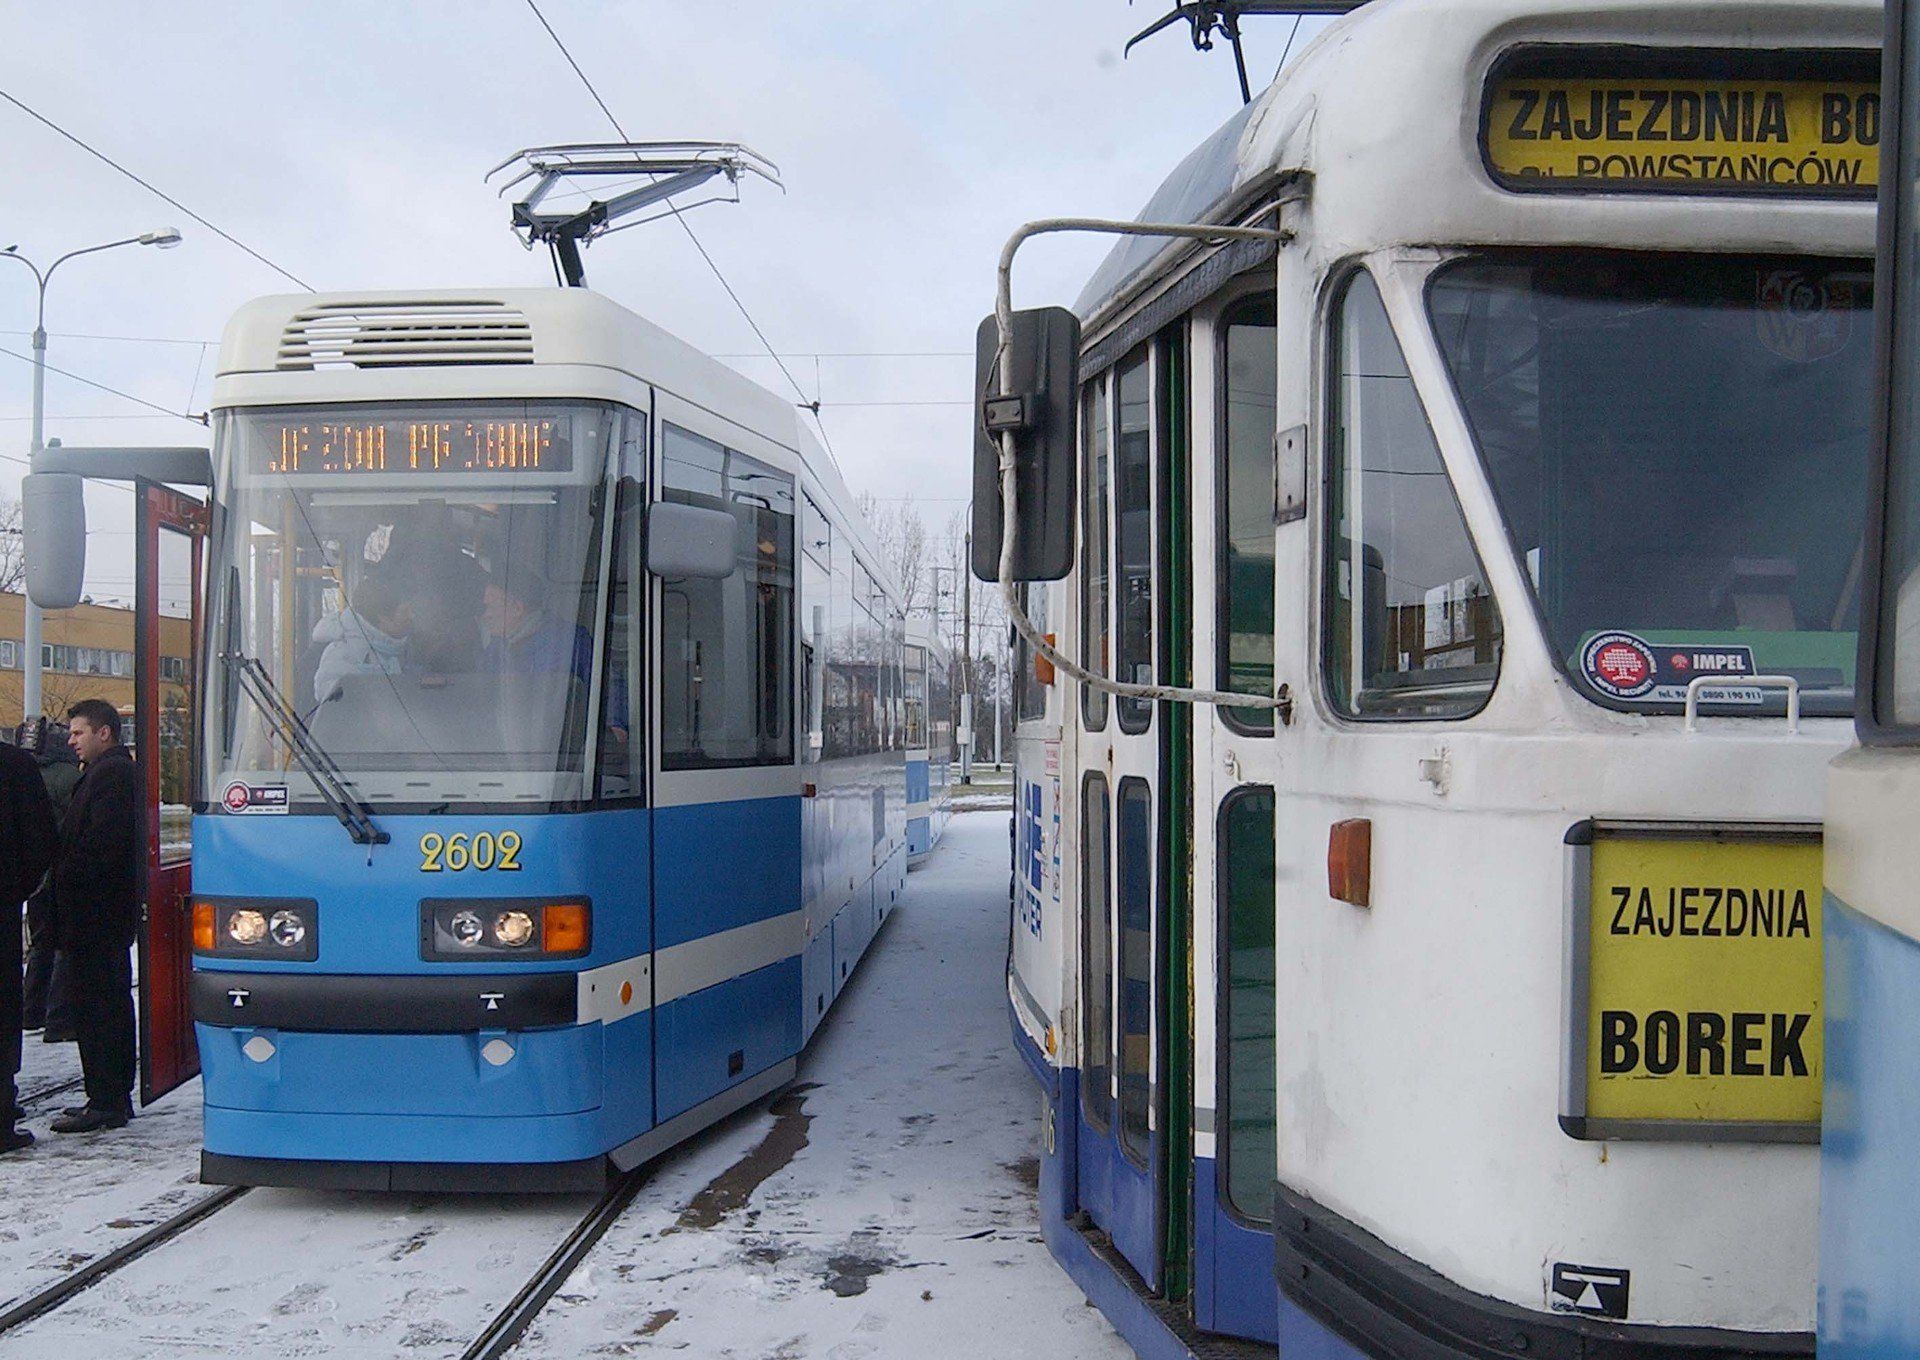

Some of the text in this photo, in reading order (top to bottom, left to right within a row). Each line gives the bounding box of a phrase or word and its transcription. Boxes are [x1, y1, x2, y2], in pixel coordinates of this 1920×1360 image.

[1508, 89, 1880, 145] ZAJEZDNIA BO
[1577, 151, 1863, 185] POWSTAŃCÓW
[1692, 654, 1746, 671] IMPEL
[420, 829, 522, 872] 2602
[1610, 886, 1811, 938] ZAJEZDNIA
[1601, 1010, 1812, 1077] BOREK
